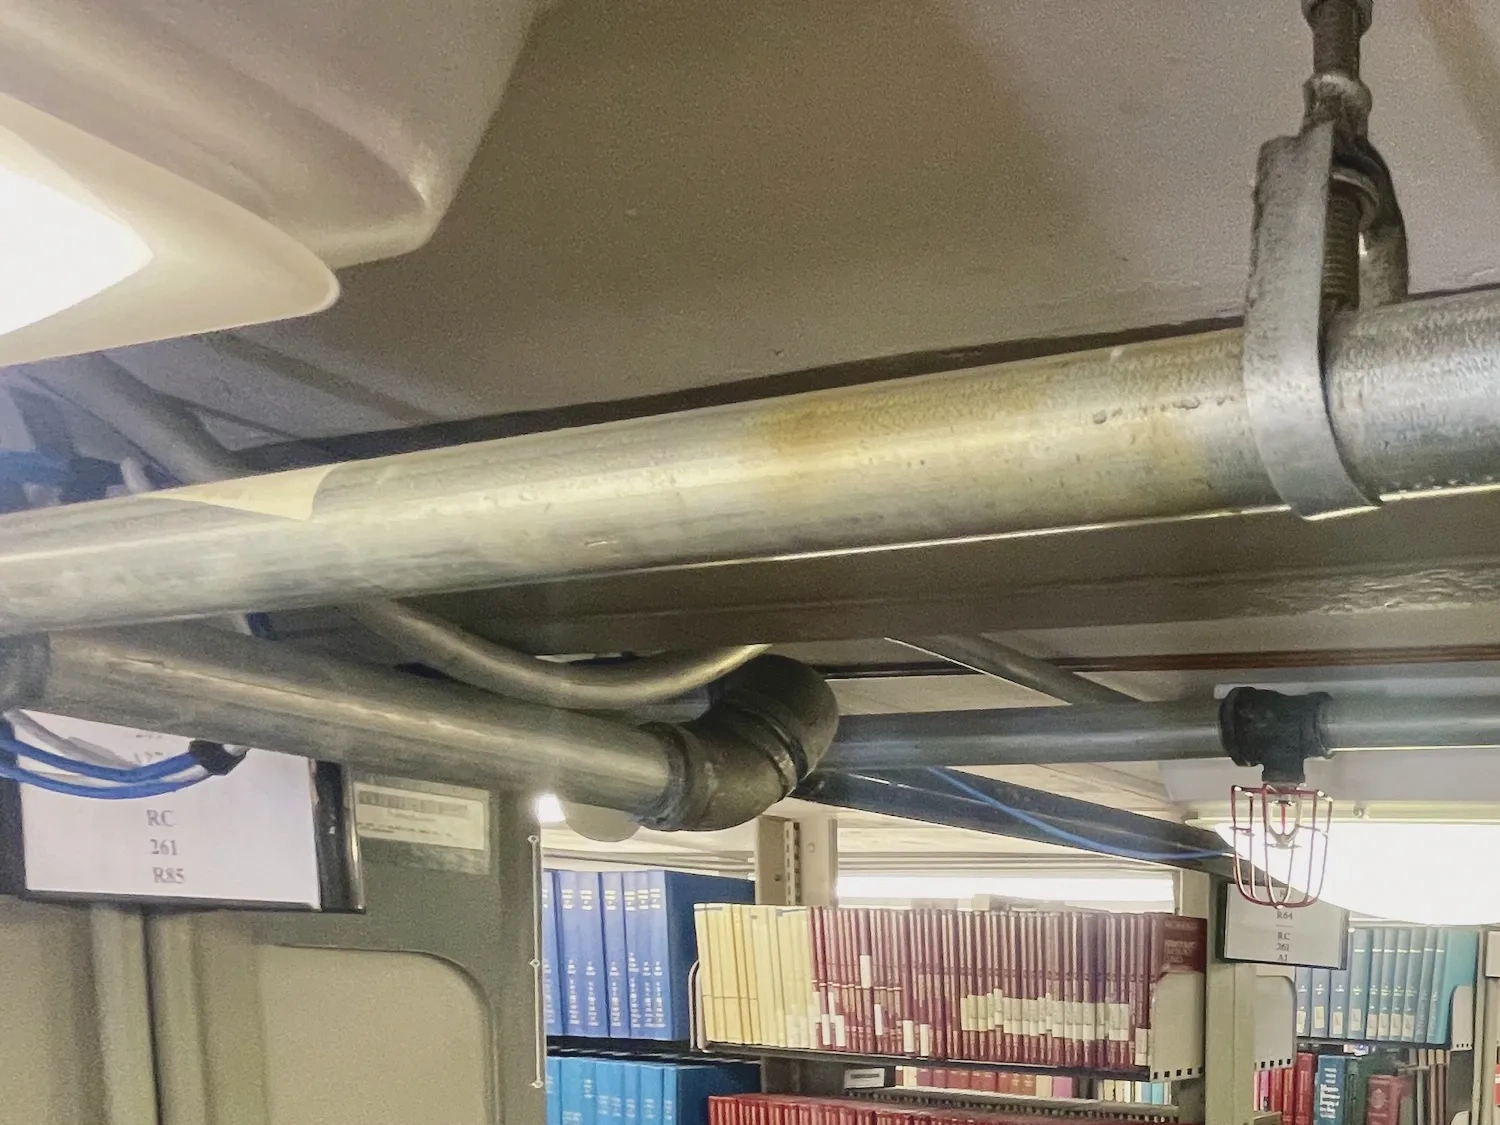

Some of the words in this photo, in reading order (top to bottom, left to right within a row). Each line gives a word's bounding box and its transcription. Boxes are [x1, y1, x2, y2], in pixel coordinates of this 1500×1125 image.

[147, 809, 175, 827] RC
[150, 838, 178, 856] 261
[1277, 932, 1291, 941] RC
